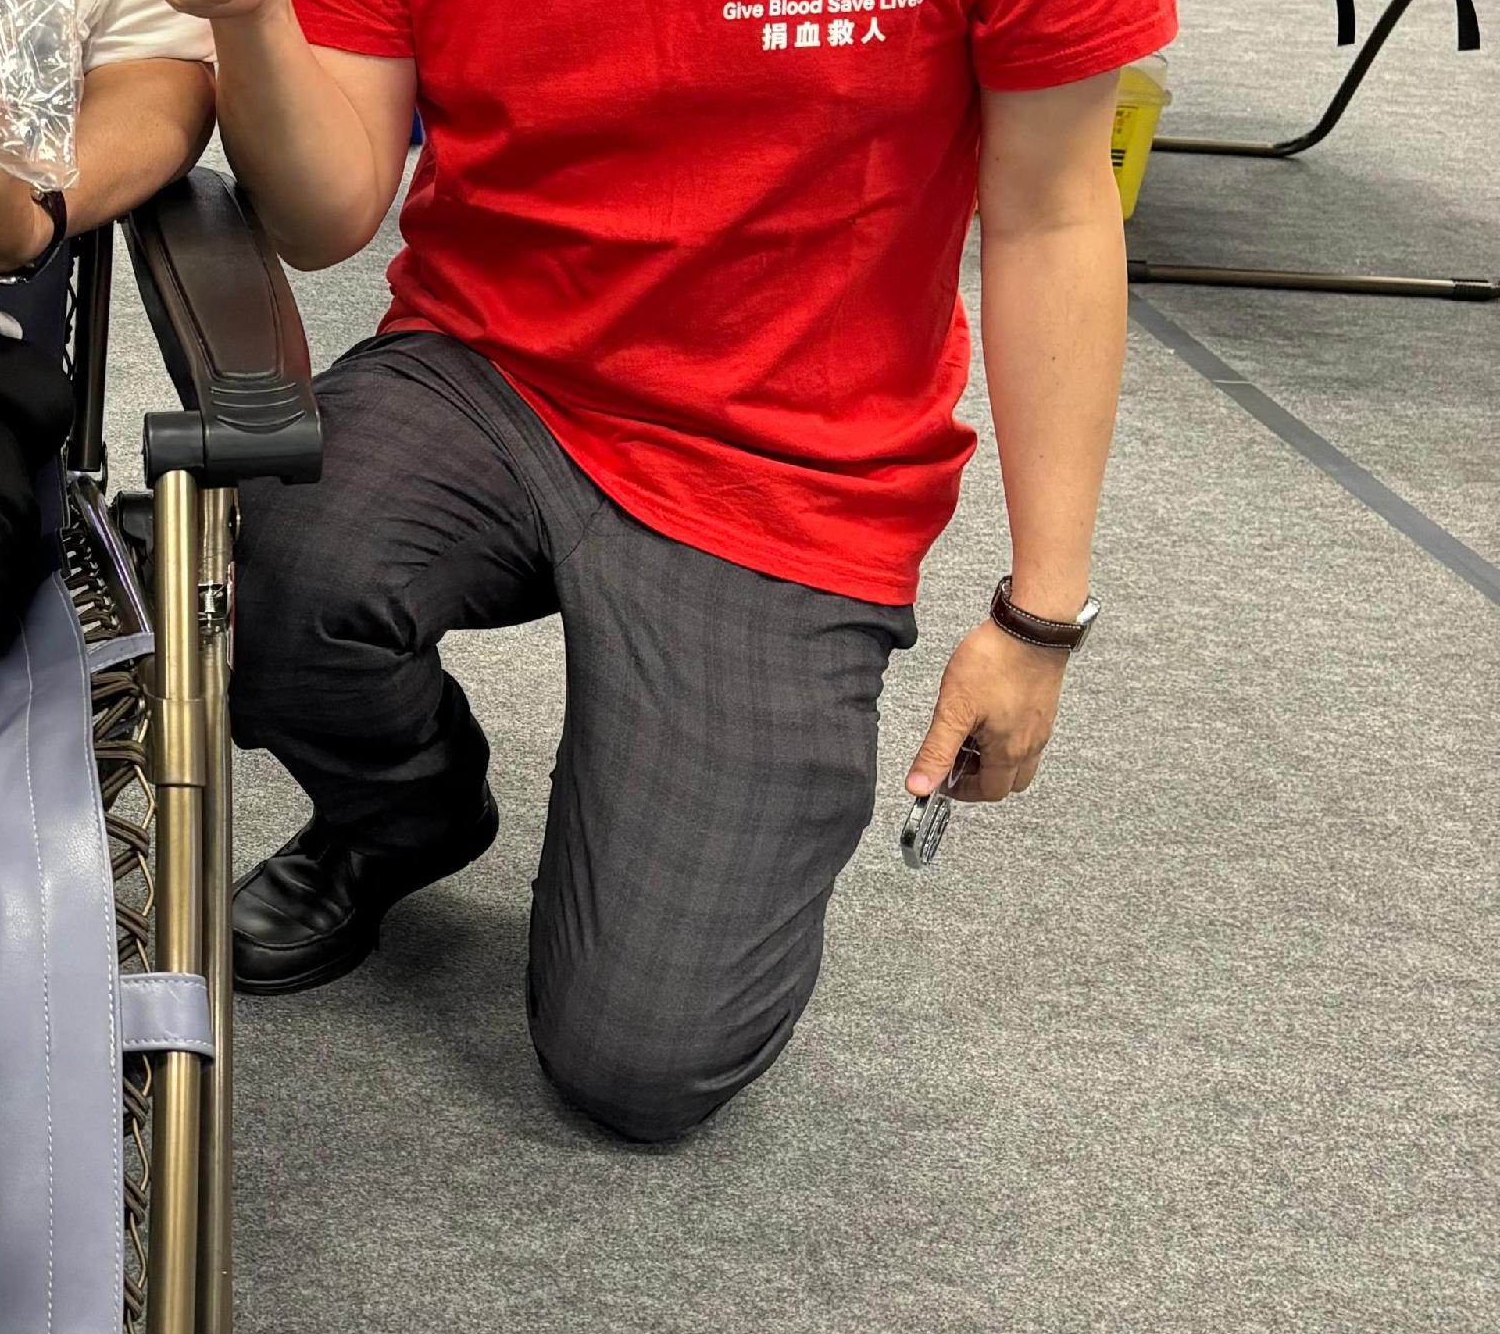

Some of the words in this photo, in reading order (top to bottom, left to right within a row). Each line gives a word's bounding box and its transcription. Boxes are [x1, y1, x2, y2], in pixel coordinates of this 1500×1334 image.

[723, 2, 764, 20] Give
[762, 17, 886, 51] 捐血救人
